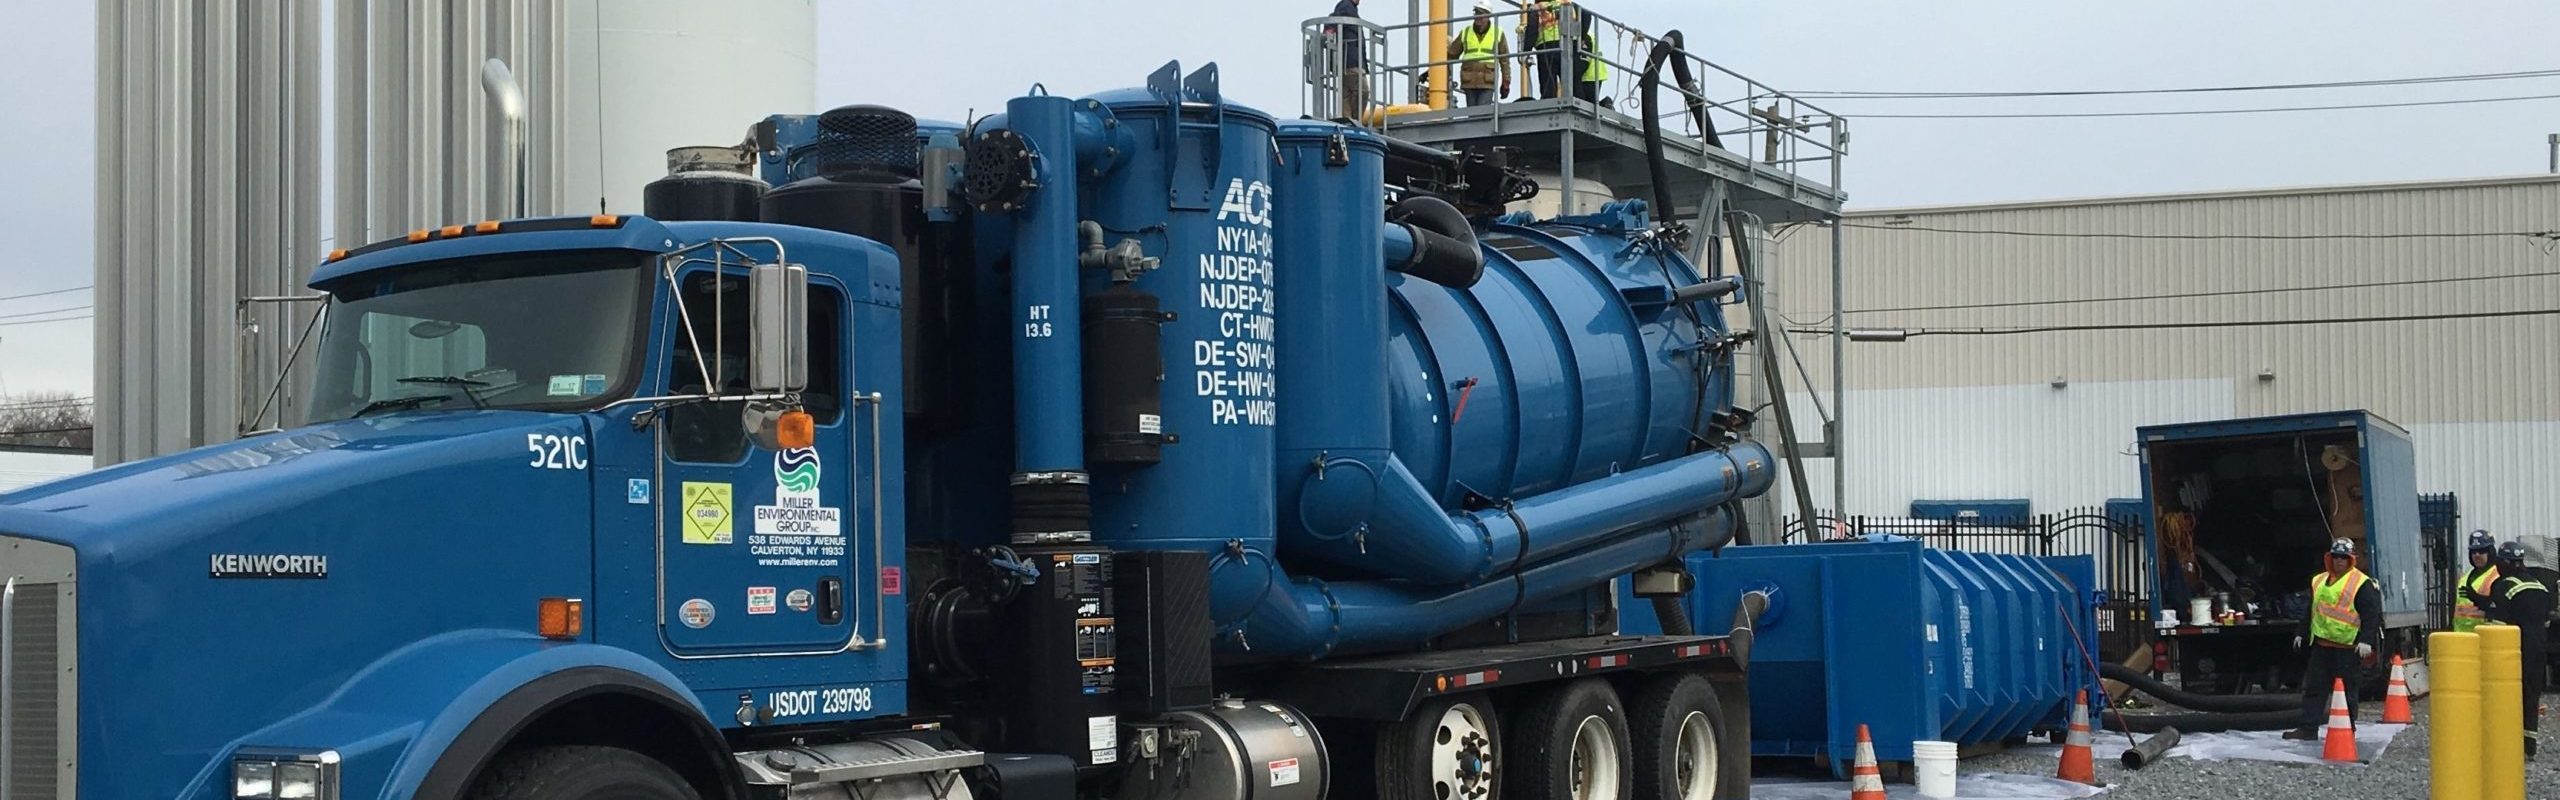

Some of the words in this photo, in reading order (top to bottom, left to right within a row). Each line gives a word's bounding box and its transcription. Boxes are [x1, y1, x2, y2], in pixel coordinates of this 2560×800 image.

[1030, 305, 1050, 320] HT
[1025, 322, 1052, 338] 13.6
[527, 433, 588, 470] 521C
[782, 497, 814, 509] MILLER
[757, 508, 838, 522] ENVIRONMENTAL
[776, 521, 811, 533] GROUP
[748, 535, 766, 545] 538
[769, 536, 811, 546] EDWARDS
[814, 537, 847, 546] AVENUE
[751, 546, 804, 556] CALVERTON,
[806, 547, 819, 555] NY
[821, 547, 845, 556] 11933
[211, 553, 328, 574] KENWORTH
[758, 557, 839, 567] www.millerenv.com
[769, 690, 818, 718] USDOT
[822, 687, 872, 713] 239798
